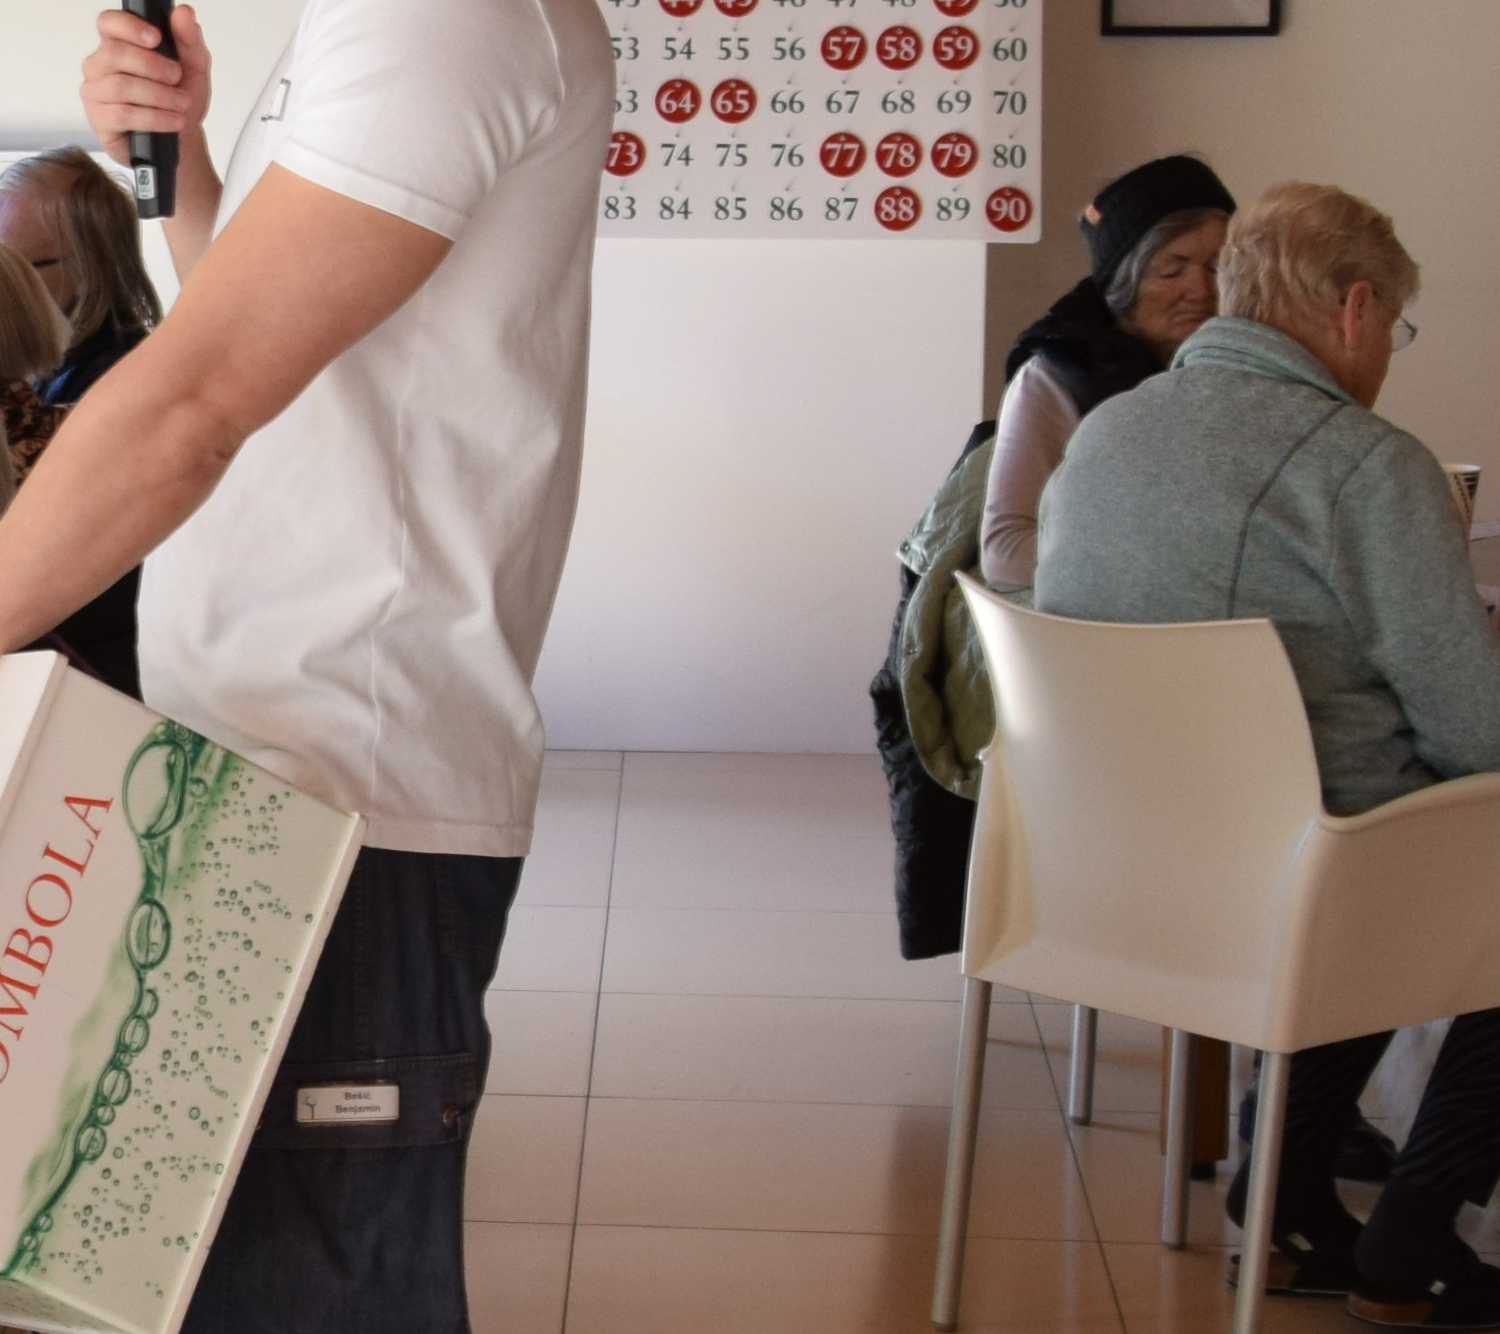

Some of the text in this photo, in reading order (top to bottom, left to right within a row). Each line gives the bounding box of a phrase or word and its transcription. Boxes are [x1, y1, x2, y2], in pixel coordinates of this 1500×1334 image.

[662, 36, 696, 61] 54
[717, 37, 750, 61] 55
[772, 36, 806, 61] 56
[827, 36, 861, 61] 57
[882, 36, 916, 61] 58
[940, 36, 973, 61] 59
[991, 37, 1028, 62] 60
[660, 90, 693, 114] 64
[714, 89, 750, 114] 65
[769, 90, 805, 114] 66
[824, 90, 861, 114] 67
[880, 89, 916, 114] 68
[935, 89, 972, 114] 69
[992, 90, 1028, 115] 70
[608, 142, 1027, 169] 73 74 75 76 77 78 79 80
[603, 195, 1026, 222] 83 84 85 86 87 88 89 90
[335, 1105, 381, 1115] Benjamin
